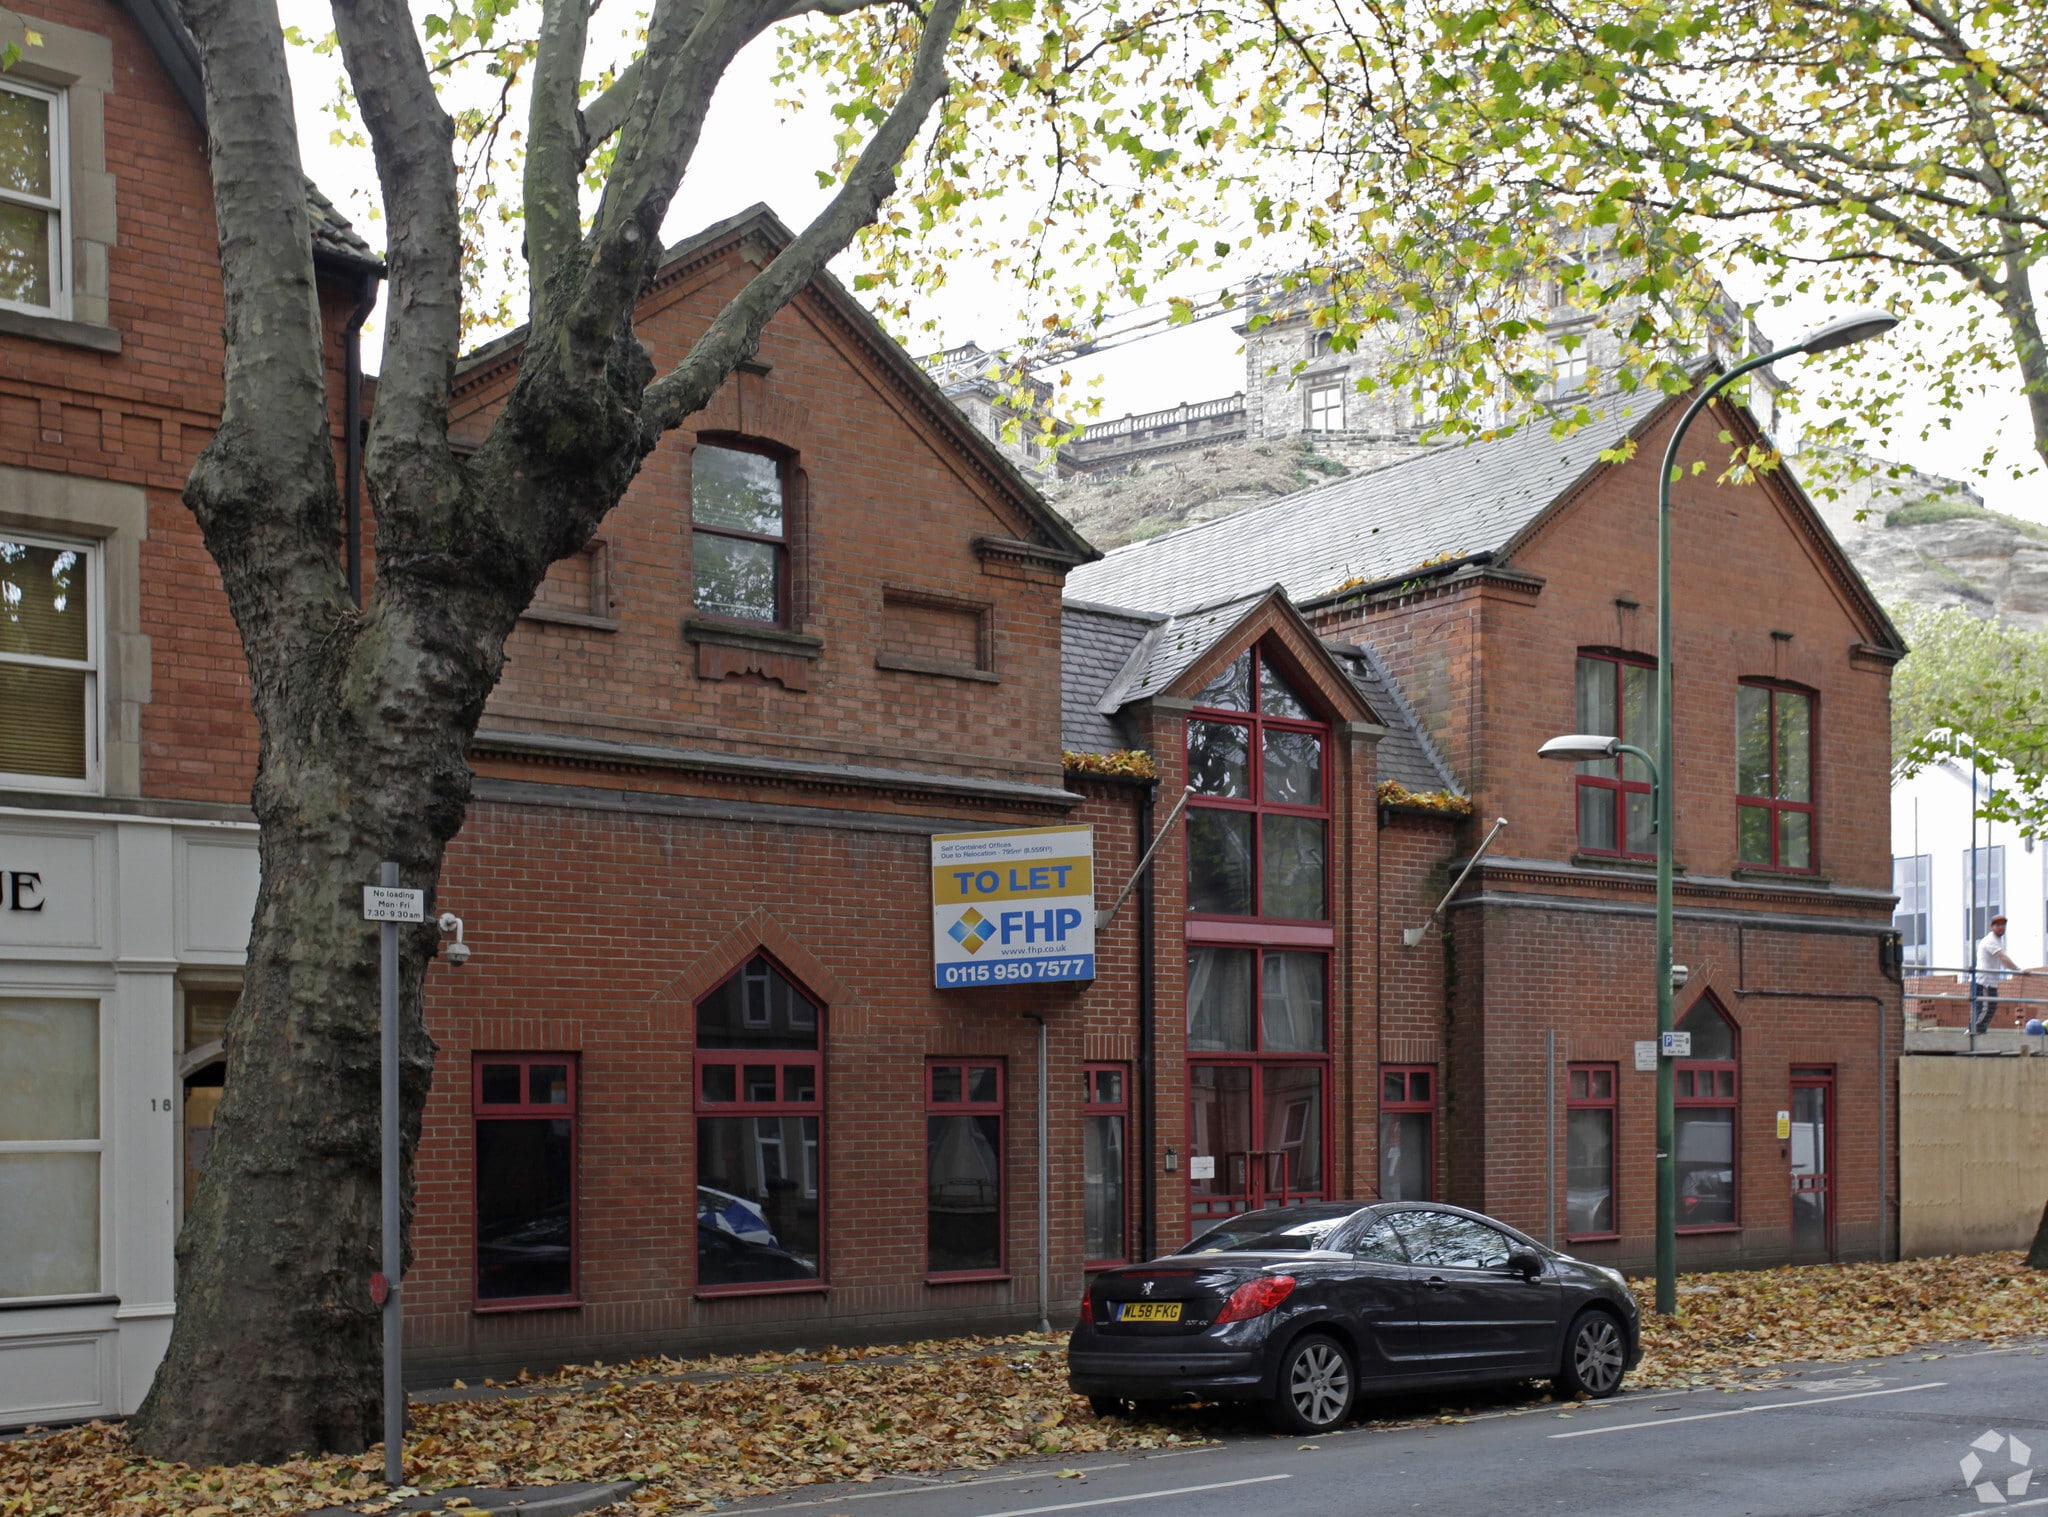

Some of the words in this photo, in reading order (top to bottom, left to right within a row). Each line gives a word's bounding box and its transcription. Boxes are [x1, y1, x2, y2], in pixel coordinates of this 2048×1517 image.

[955, 843, 987, 851] Contained
[953, 870, 1000, 895] TO
[1009, 865, 1073, 891] LET
[0, 871, 46, 912] E
[386, 890, 415, 900] loading
[378, 900, 395, 908] Mon
[399, 901, 410, 909] Fri
[1000, 908, 1082, 945] FHP
[1001, 944, 1067, 955] www.fhp.co.uk
[945, 965, 990, 983] 0115
[994, 962, 1033, 980] 950
[1036, 959, 1085, 977] 7577
[151, 1098, 172, 1112] 18
[1123, 1304, 1153, 1318] WL58
[1154, 1304, 1179, 1318] FKG
